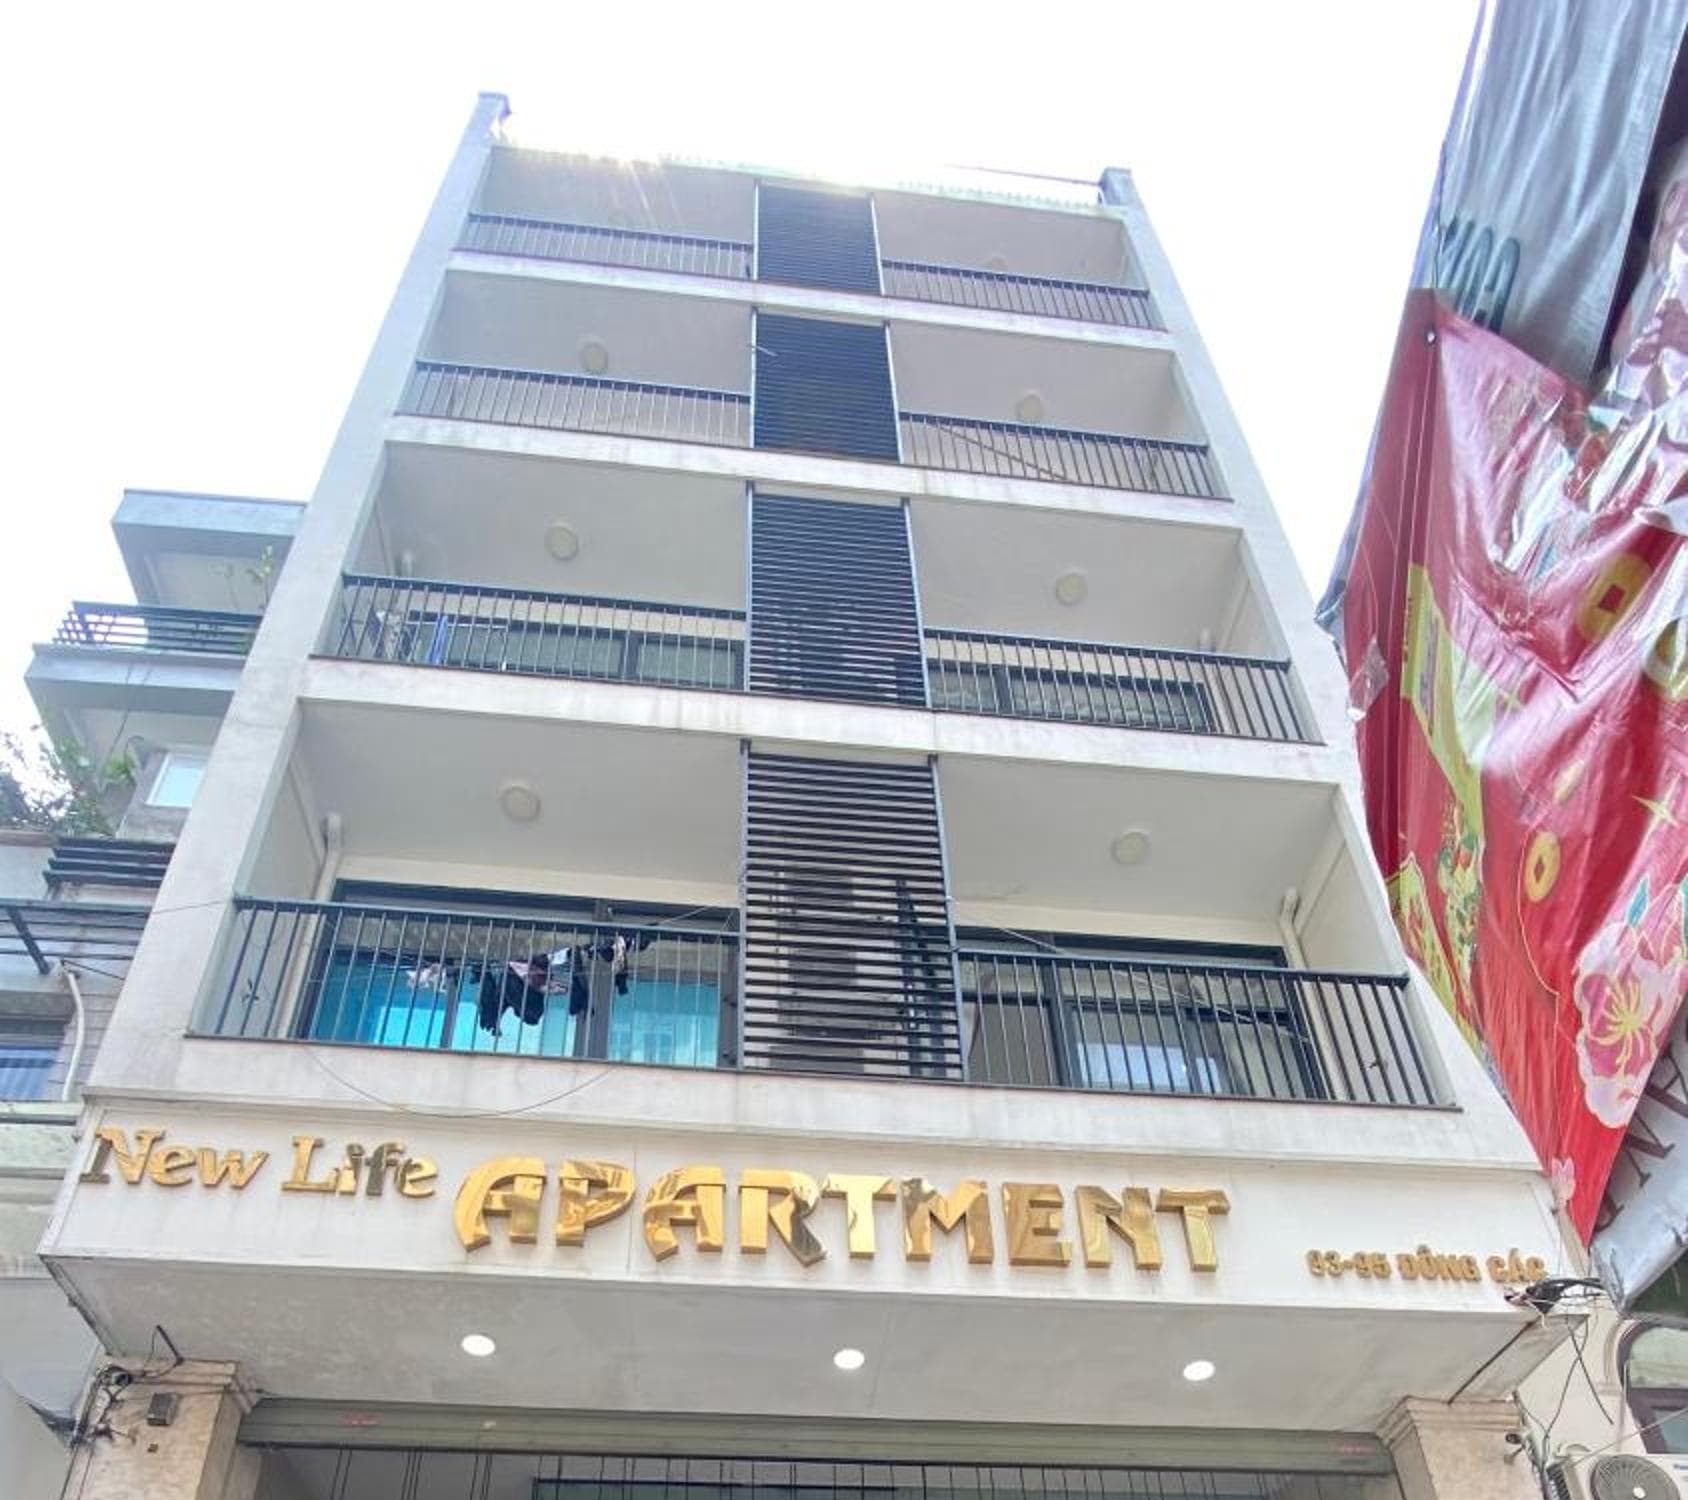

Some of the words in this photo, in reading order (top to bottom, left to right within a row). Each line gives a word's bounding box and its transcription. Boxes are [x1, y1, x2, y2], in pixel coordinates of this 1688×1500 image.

[80, 1127, 267, 1188] New
[282, 1135, 439, 1199] Life
[453, 1155, 1232, 1273] APARTMENT
